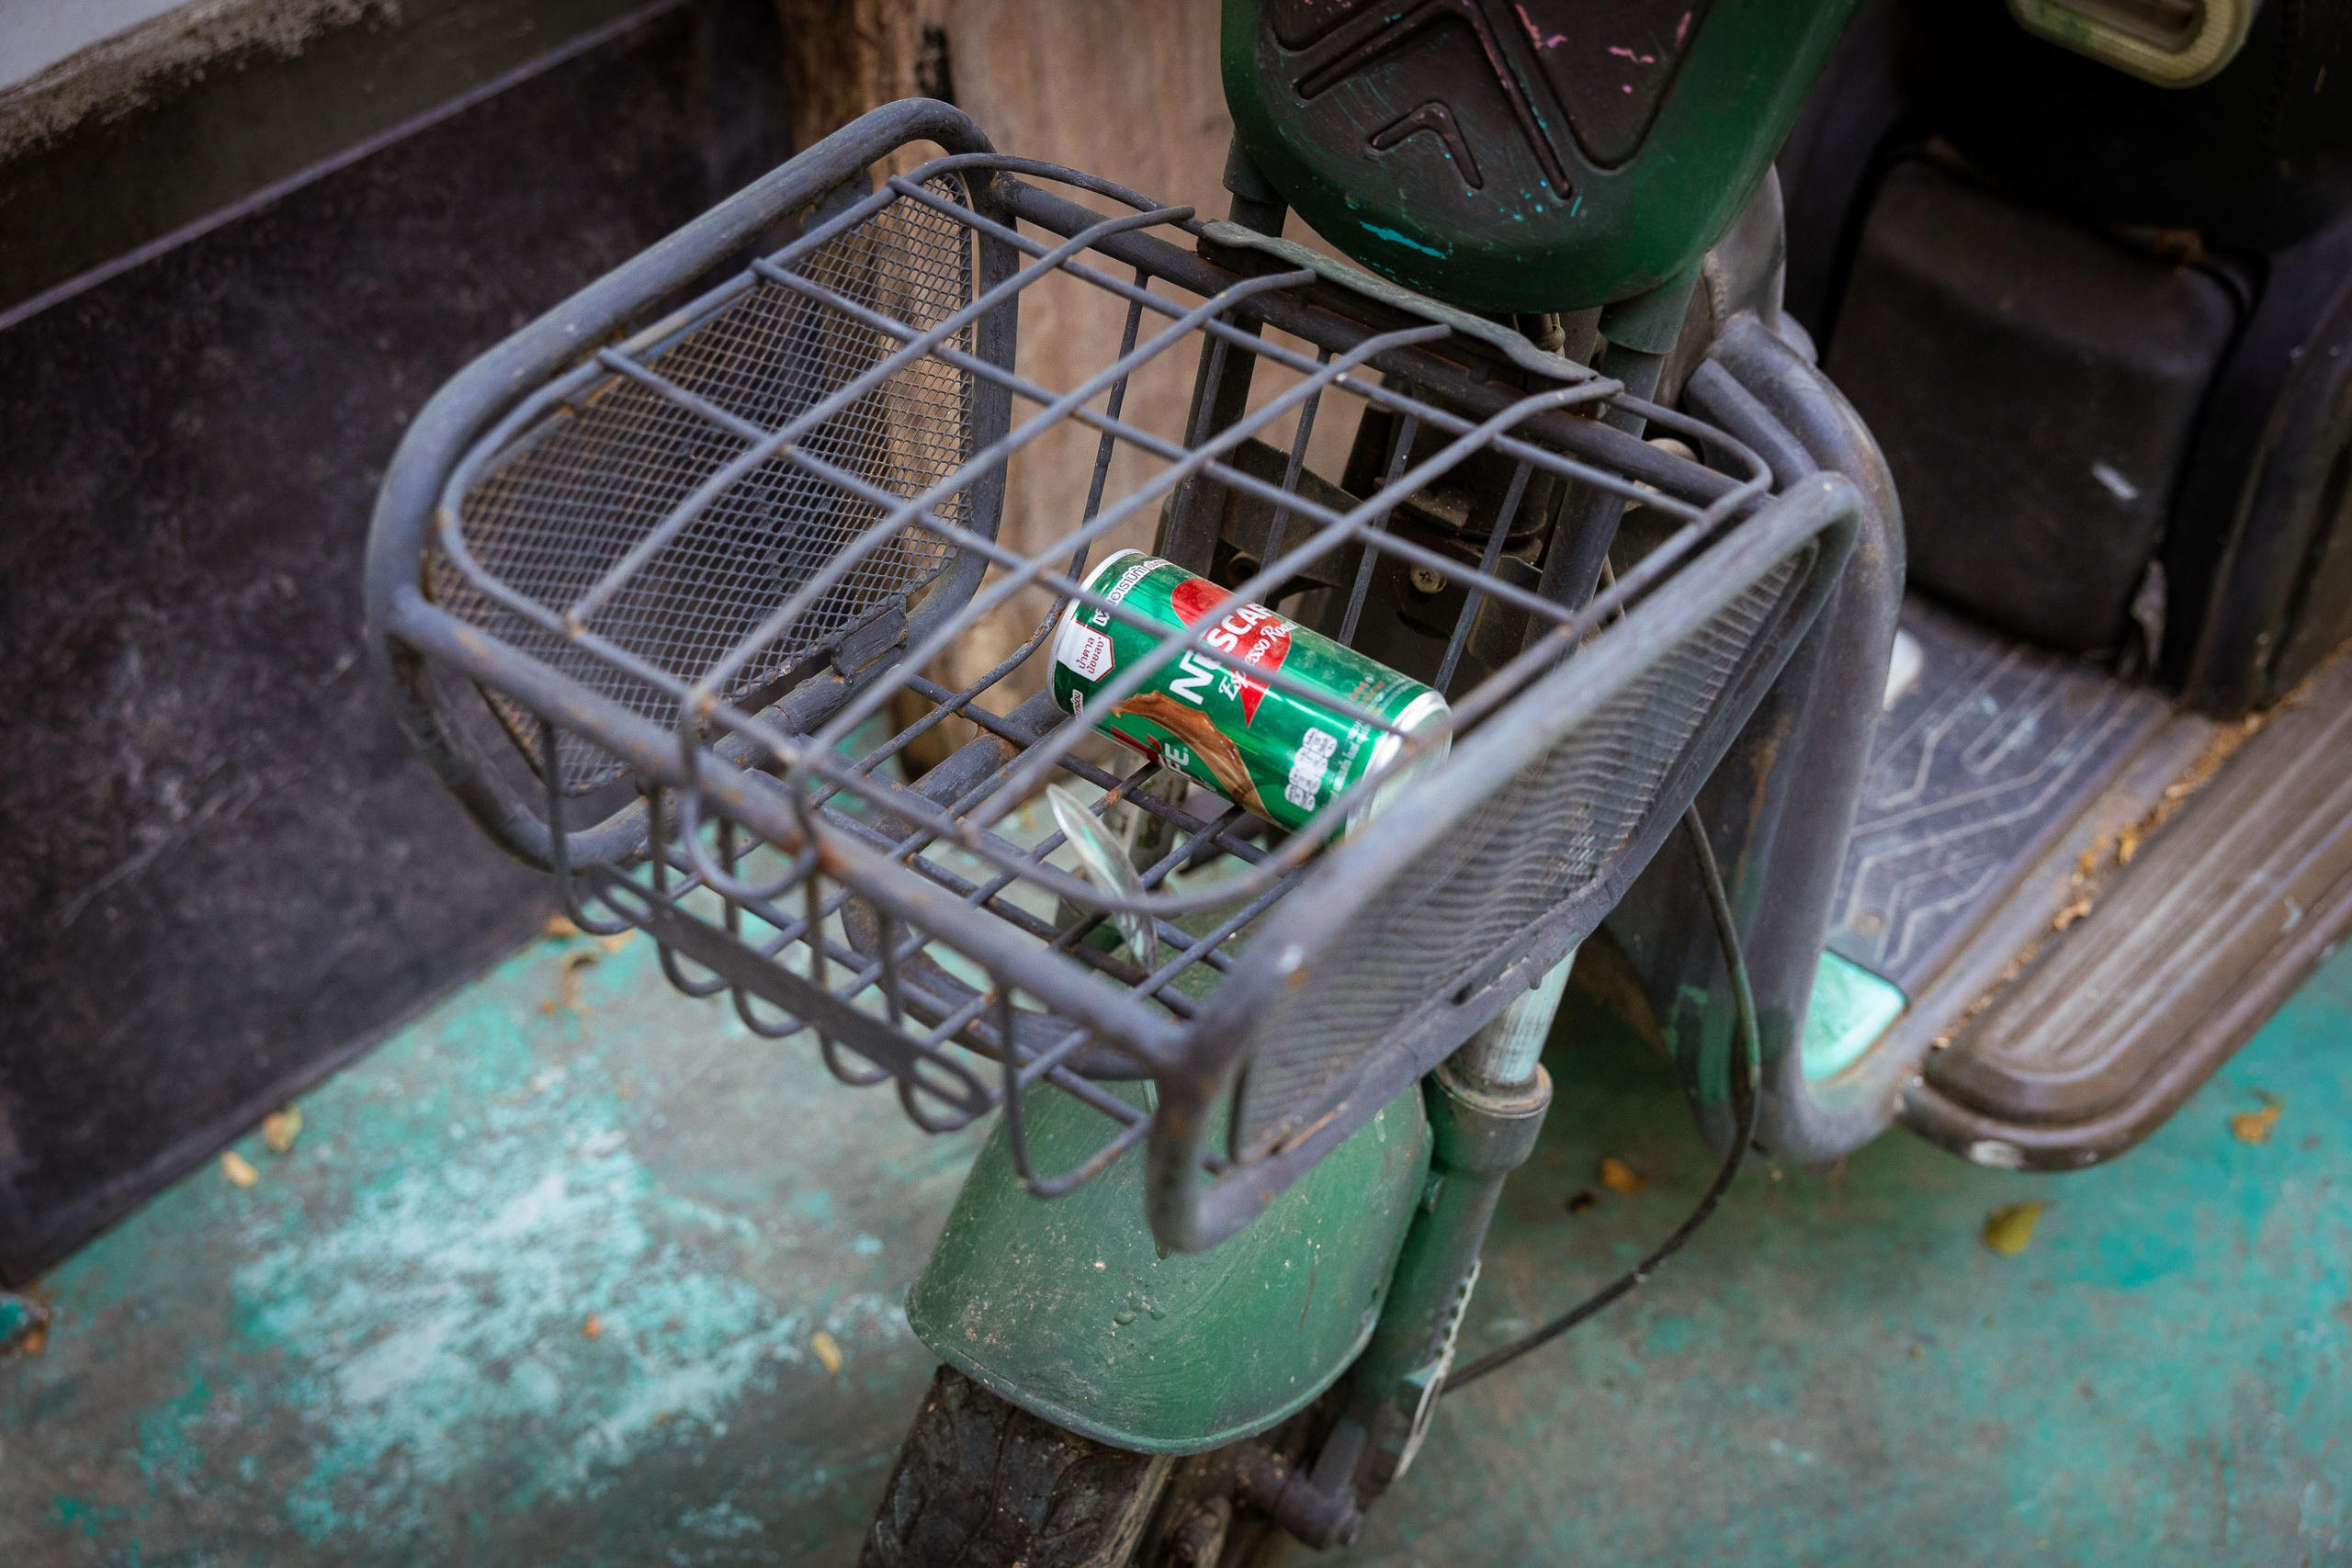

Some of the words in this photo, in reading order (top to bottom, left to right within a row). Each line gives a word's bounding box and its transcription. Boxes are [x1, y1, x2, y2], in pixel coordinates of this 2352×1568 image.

[1076, 637, 1095, 670] น้ำตาล
[1217, 637, 1272, 702] Espesso
